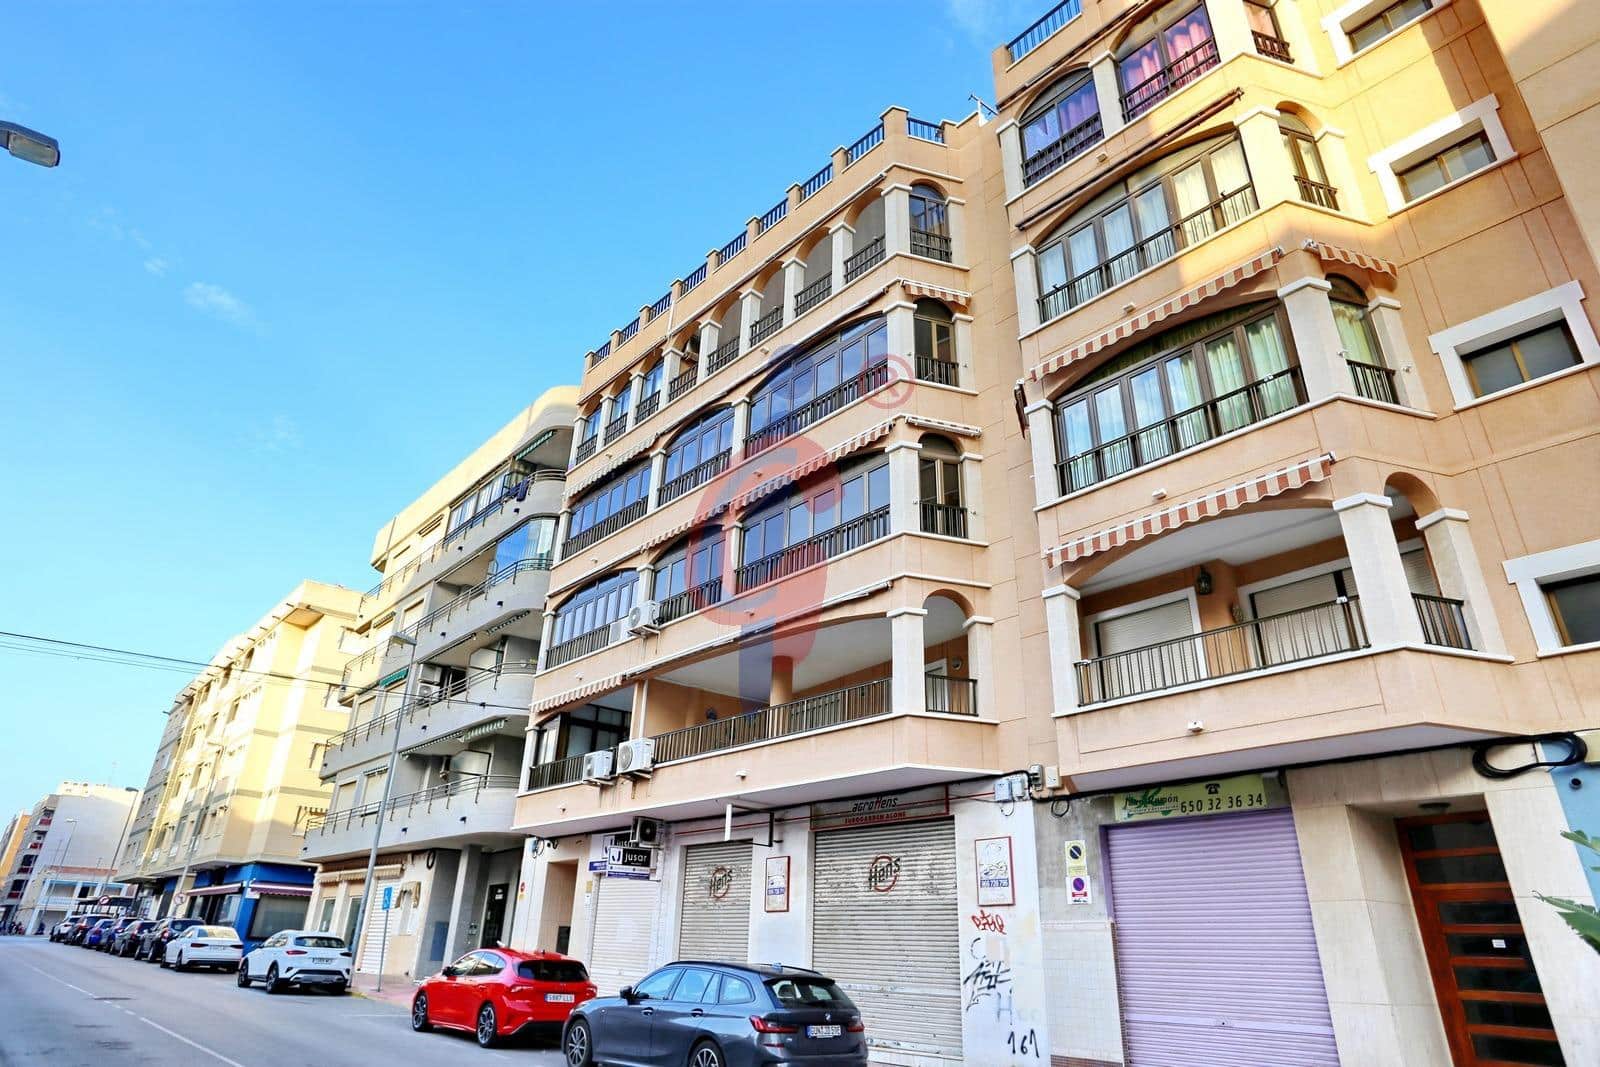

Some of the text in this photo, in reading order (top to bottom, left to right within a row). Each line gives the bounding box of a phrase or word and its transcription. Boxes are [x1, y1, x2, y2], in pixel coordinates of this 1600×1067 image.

[1180, 801, 1203, 813] 650
[1207, 798, 1221, 810] 32
[1228, 796, 1242, 808] 36
[1248, 793, 1263, 806] 34
[624, 852, 647, 863] jusar
[709, 868, 733, 898] Hens
[868, 856, 900, 890] Hens
